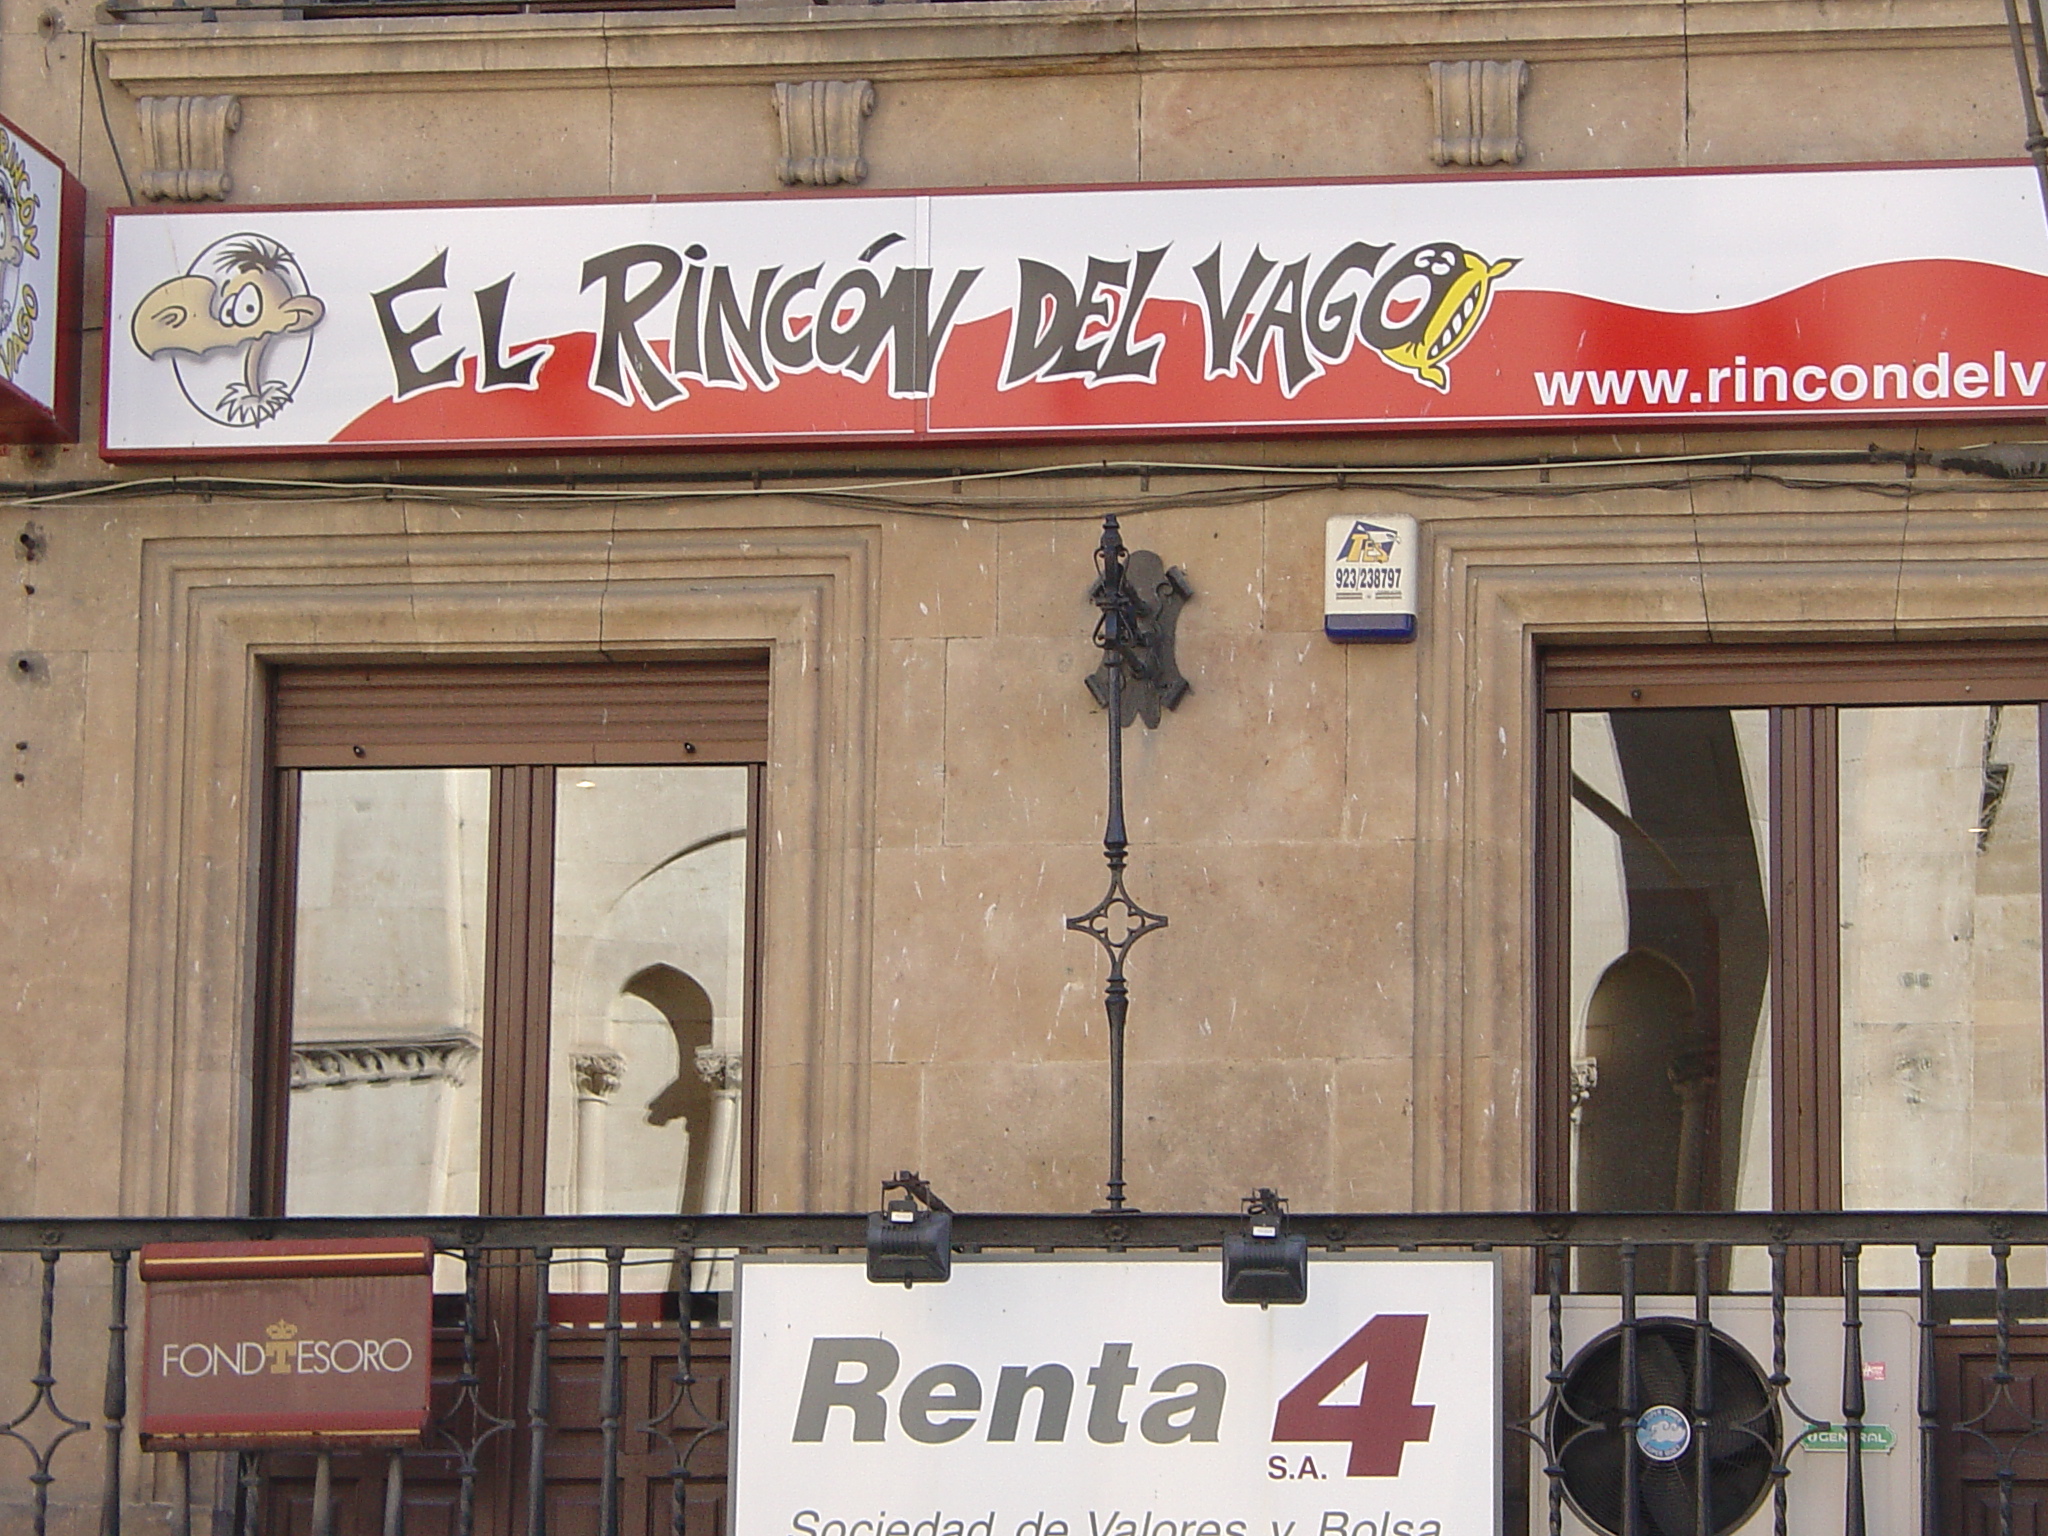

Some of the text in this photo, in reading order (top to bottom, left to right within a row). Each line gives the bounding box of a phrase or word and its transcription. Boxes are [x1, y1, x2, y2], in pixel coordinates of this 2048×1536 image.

[370, 246, 554, 401] EL
[998, 240, 1175, 390] DEL
[1191, 240, 1523, 398] VAGO
[1533, 350, 2047, 407] www.rincondelv
[1346, 533, 1390, 563] TES
[1335, 567, 1402, 591] 923/238797
[791, 1314, 1436, 1478] Renta 4
[1820, 1432, 1888, 1443] GENRAL
[1267, 1455, 1328, 1481] S.A.
[788, 1509, 996, 1536] Sociedad
[1016, 1511, 1069, 1536] de
[1089, 1511, 1247, 1536] Valores
[1319, 1511, 1442, 1536] Bolsa
